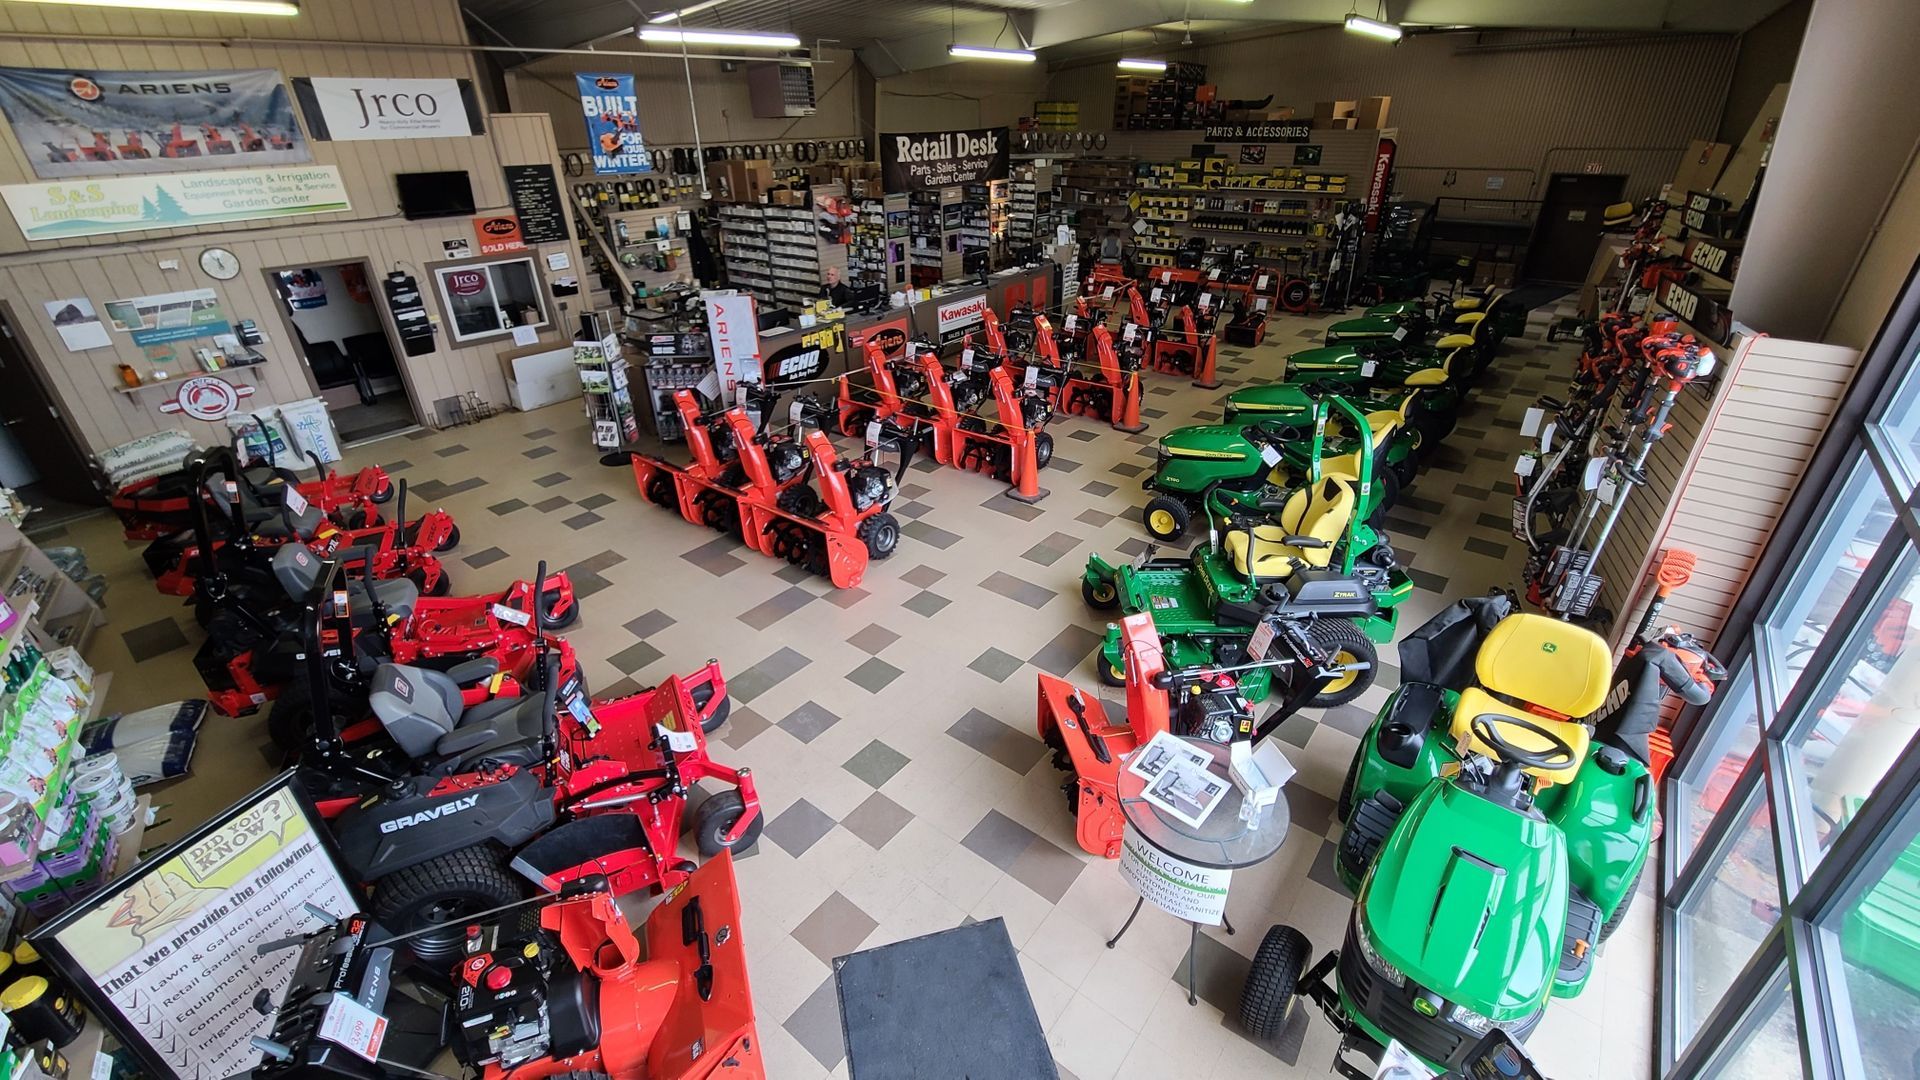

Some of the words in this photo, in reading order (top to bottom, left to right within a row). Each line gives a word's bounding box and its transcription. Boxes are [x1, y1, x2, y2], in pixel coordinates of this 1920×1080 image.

[118, 82, 232, 96] ARIENS
[351, 88, 438, 129] Jrco
[581, 95, 638, 117] BUILT
[620, 132, 643, 145] FOR
[895, 133, 953, 163] Retail
[956, 130, 998, 158] Desk
[1206, 126, 1234, 138] PARTS
[1235, 126, 1244, 137] &
[1245, 126, 1309, 138] ACCESSORIES
[623, 144, 645, 154] YOUR
[181, 175, 263, 189] Landscaping
[265, 174, 275, 183] &
[277, 171, 331, 184] Irrigation
[910, 164, 931, 176] Parts
[936, 162, 957, 174] Sales
[962, 159, 988, 171] Service
[925, 174, 952, 186] Garden
[953, 171, 977, 183] Center
[48, 186, 66, 206] S
[87, 184, 105, 202] S
[183, 189, 236, 200] Equipment
[267, 185, 294, 194] Sales
[303, 182, 338, 190] Service
[1367, 153, 1391, 216] Kawasaki
[30, 202, 140, 222] Landscaping
[223, 195, 270, 209] Garden
[272, 193, 311, 206] Center
[482, 243, 505, 253] SOLD
[1690, 240, 1727, 274] ECHO
[453, 274, 479, 288] Jrco
[941, 300, 986, 322] Kawasaki
[1666, 282, 1699, 322] ECHO
[713, 303, 737, 392] ARIENS
[779, 349, 820, 377] ECHO
[380, 793, 480, 834] GRAVELY
[190, 834, 224, 861] DID
[227, 809, 262, 835] YOU
[195, 817, 265, 872] KNOW
[1136, 840, 1211, 885] WELCOME
[1135, 868, 1180, 899] CUSTOMERS
[1181, 895, 1200, 905] AND
[1140, 863, 1153, 876] THE
[1154, 874, 1183, 892] SAFETY
[1183, 888, 1195, 896] OF
[1196, 891, 1216, 901] OUR
[1139, 887, 1159, 905] YOUR
[1160, 900, 1188, 917] HANDS
[1155, 891, 1182, 909] PLEASE
[1185, 902, 1220, 916] SANITIZE
[100, 963, 143, 996] That
[143, 945, 171, 968] we
[171, 906, 230, 951] provide
[229, 887, 256, 909] the
[150, 965, 189, 994] Lawn
[191, 953, 204, 964] &
[206, 917, 254, 952] Garden
[254, 867, 317, 917] Equipment
[351, 919, 363, 935] 32
[162, 977, 201, 1008] Retail
[202, 944, 246, 978] Garden
[247, 914, 284, 944] Center
[176, 964, 250, 1023] Equipment
[284, 928, 295, 938] &
[296, 895, 337, 929] Serice
[188, 976, 264, 1038] Commercial
[264, 949, 297, 978] Snow
[364, 965, 381, 1010] RIENS
[198, 1005, 254, 1051] Irrigation
[210, 1014, 270, 1064] Landscape
[221, 1057, 247, 1078] Dirt,
